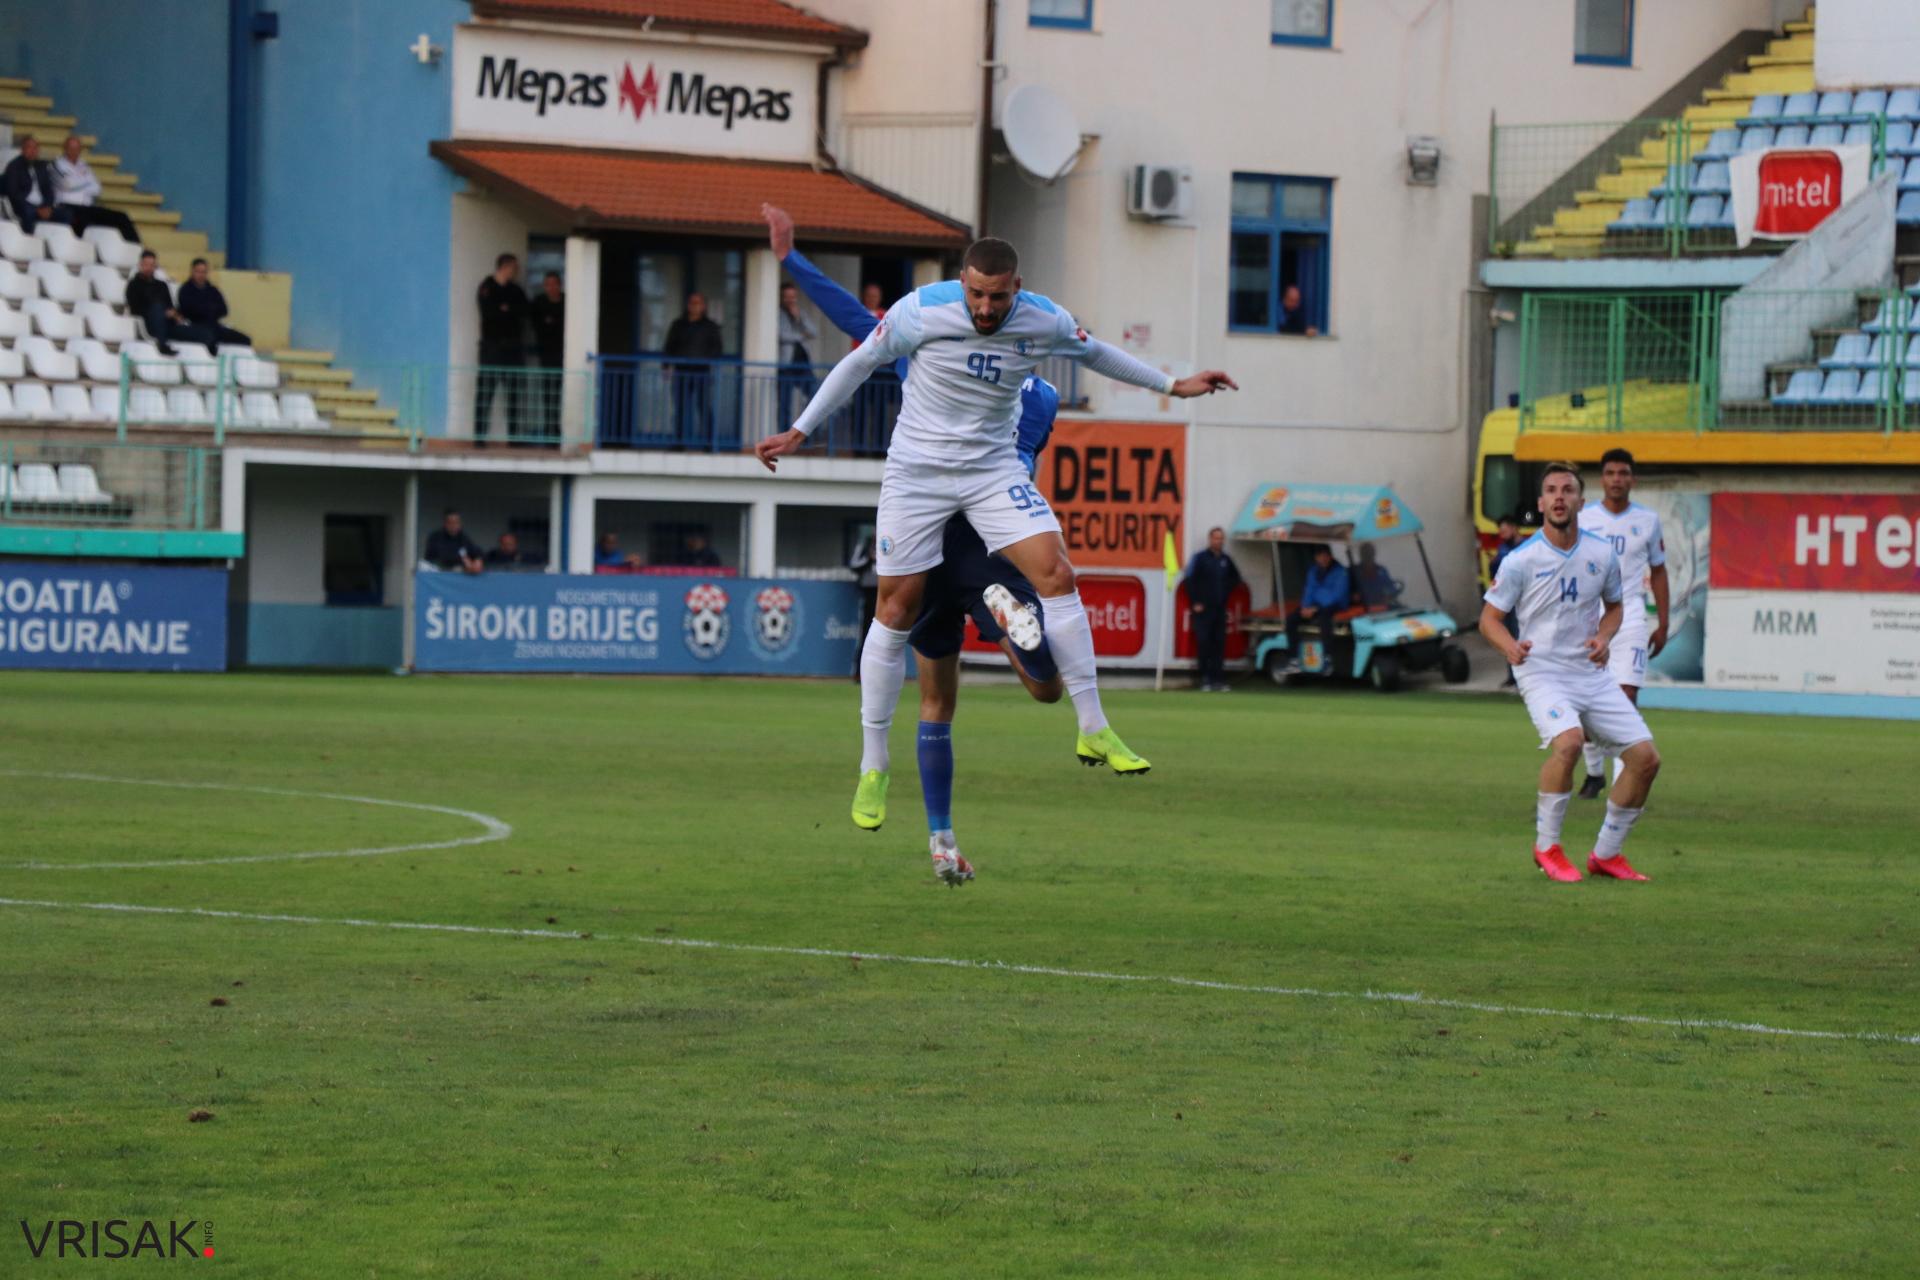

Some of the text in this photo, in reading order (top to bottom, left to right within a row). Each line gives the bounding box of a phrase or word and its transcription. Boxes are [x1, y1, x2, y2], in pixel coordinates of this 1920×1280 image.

[477, 55, 793, 130] Mepas Mepas
[1763, 173, 1831, 208] m:tel
[967, 352, 1002, 384] 95
[1054, 446, 1181, 503] DELTA
[1008, 484, 1047, 511] 95
[1795, 514, 1920, 569] HTe
[1560, 576, 1578, 602] 14
[425, 597, 538, 640] ŠIROKI
[547, 605, 659, 642] BRIJEG
[1752, 609, 1818, 636] MRM
